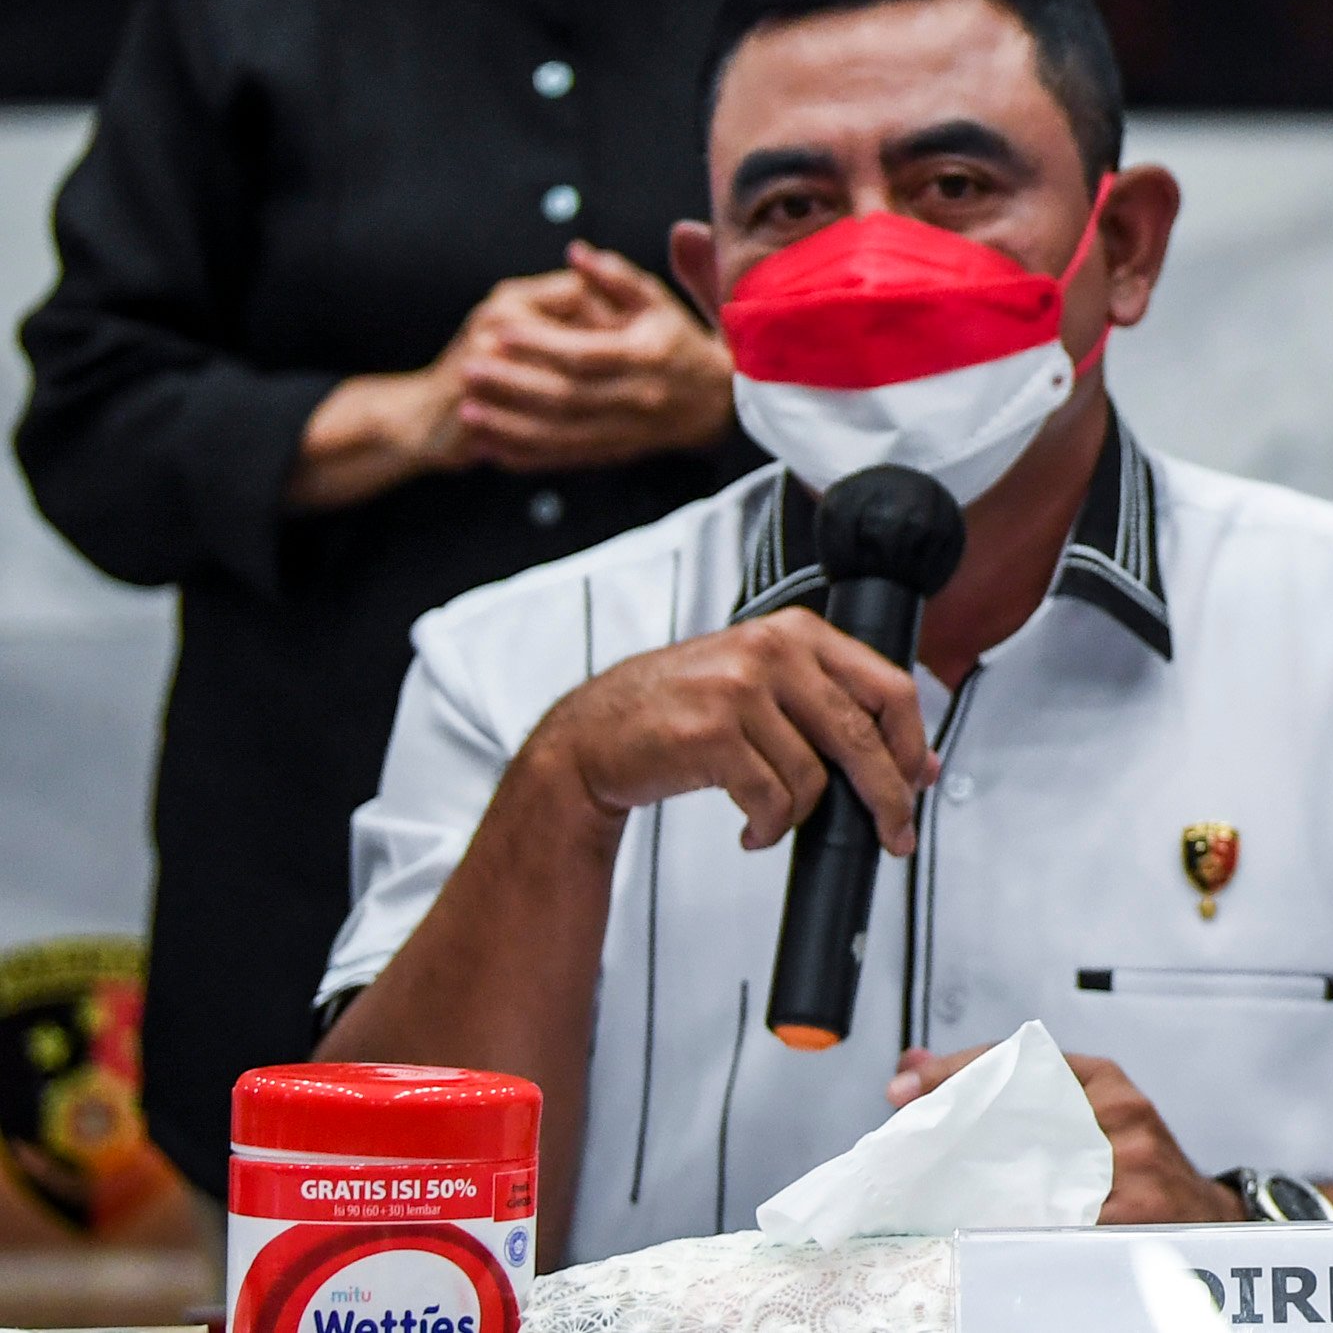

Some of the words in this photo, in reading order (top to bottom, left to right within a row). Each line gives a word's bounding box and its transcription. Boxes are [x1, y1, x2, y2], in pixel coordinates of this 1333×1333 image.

[301, 1179, 387, 1200] GRATIS
[391, 1179, 421, 1199] ISI
[426, 1178, 477, 1199] 50%
[406, 1204, 441, 1215] lembar
[331, 1287, 372, 1303] mitu
